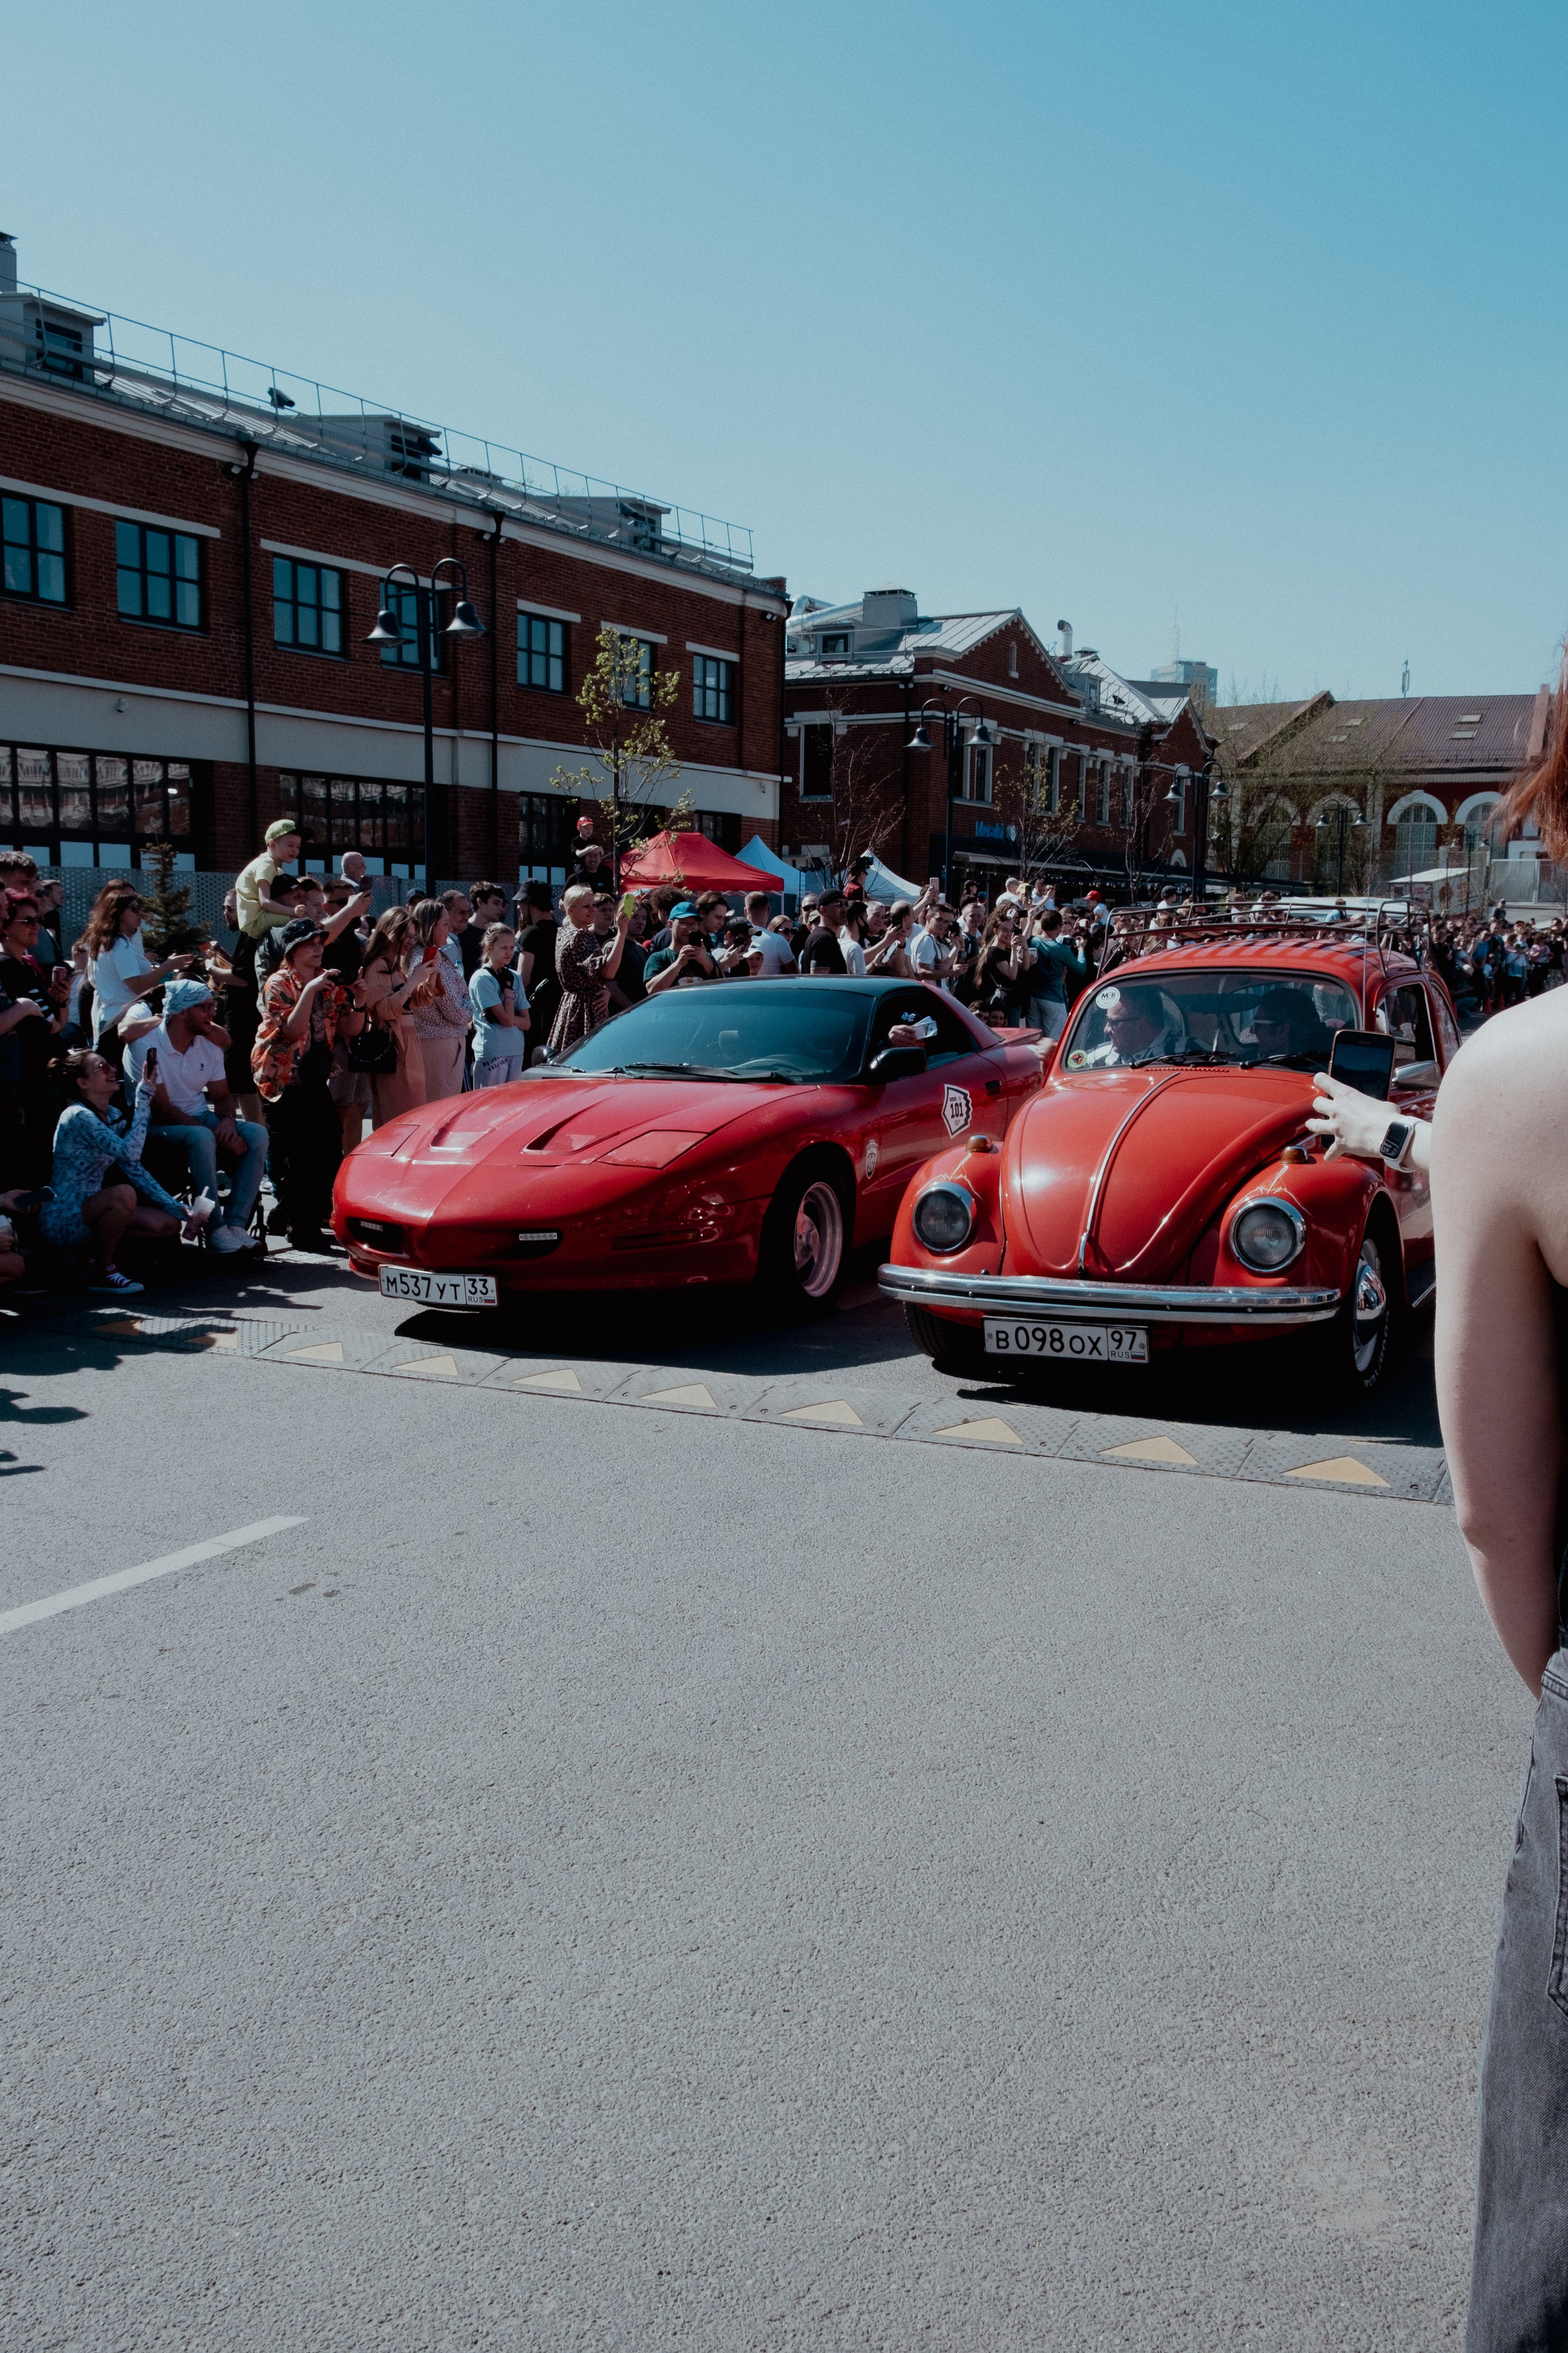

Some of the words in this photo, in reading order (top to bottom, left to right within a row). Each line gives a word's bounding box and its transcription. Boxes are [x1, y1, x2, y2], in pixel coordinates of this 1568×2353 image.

[950, 1102, 963, 1119] 101
[467, 1278, 489, 1296] 33
[1110, 1330, 1137, 1351] 97
